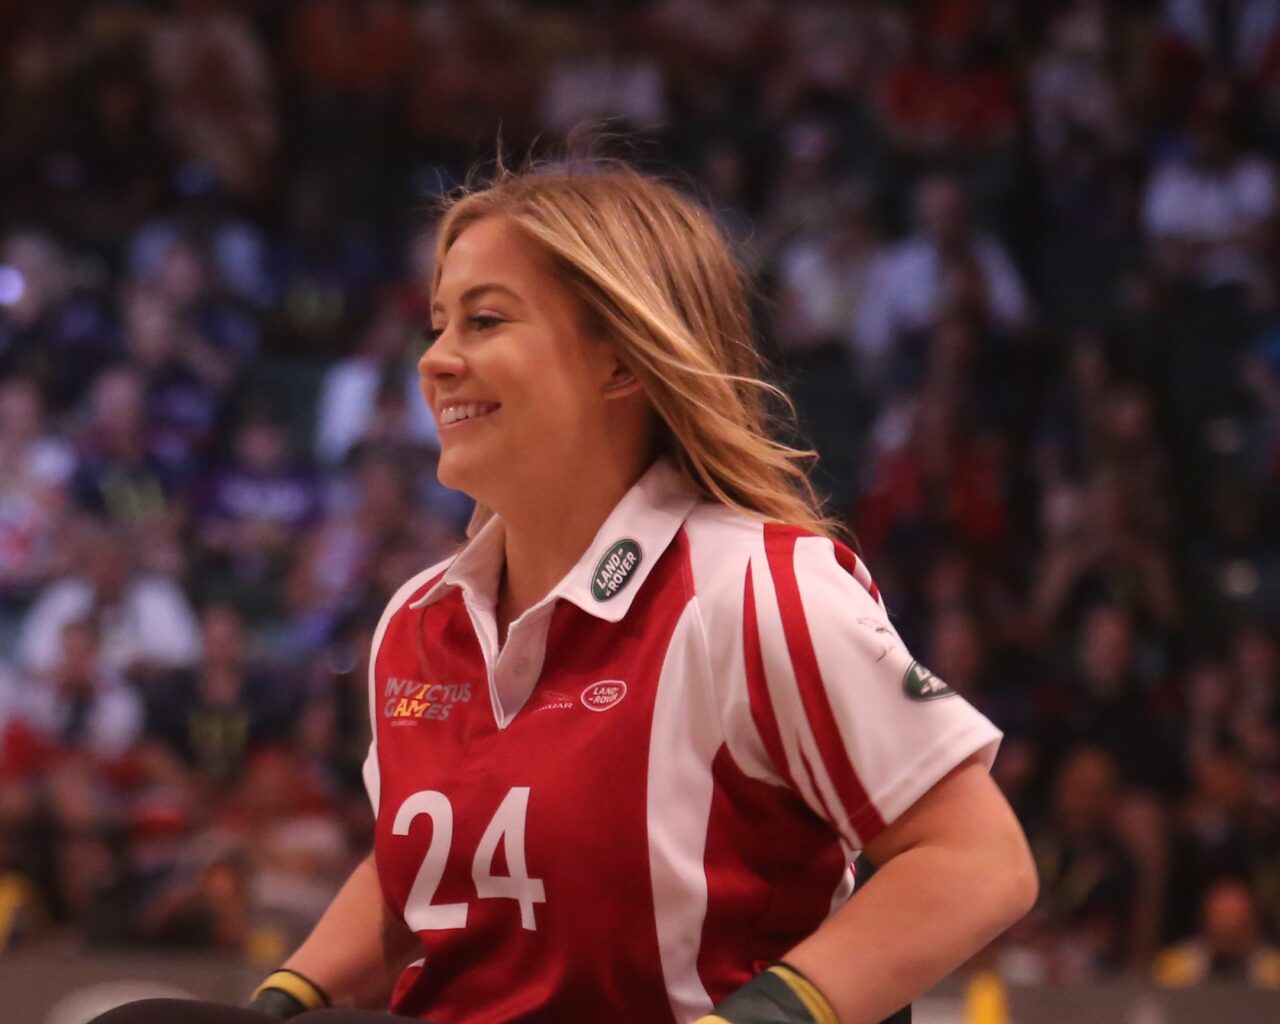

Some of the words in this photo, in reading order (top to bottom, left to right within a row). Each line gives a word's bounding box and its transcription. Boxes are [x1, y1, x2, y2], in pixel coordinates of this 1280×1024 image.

[596, 554, 620, 589] LAND
[608, 552, 637, 591] ROVER
[385, 677, 472, 702] INVICTUS
[383, 698, 452, 720] GAMES
[392, 786, 545, 932] 24
